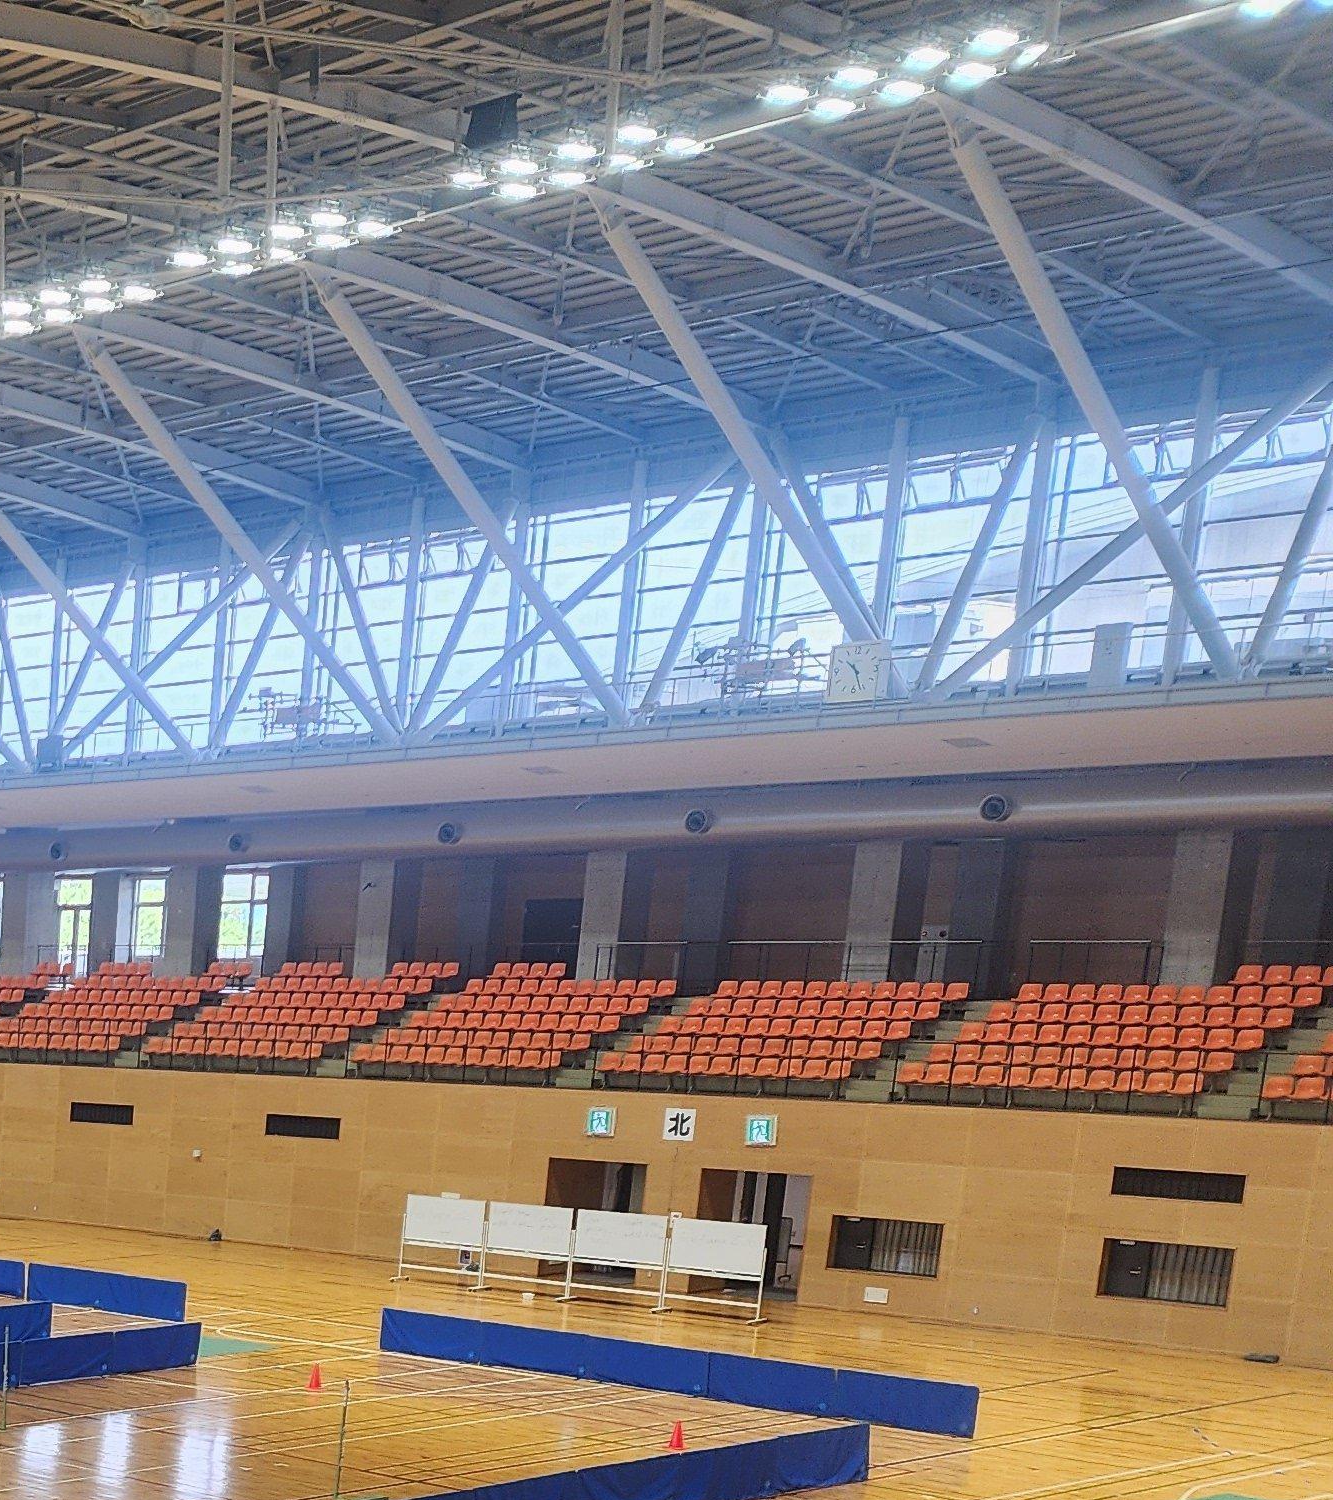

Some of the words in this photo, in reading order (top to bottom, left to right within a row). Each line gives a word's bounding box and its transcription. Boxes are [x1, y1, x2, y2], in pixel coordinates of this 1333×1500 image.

[854, 646, 862, 654] 12
[833, 668, 840, 676] 9
[873, 664, 879, 672] 3
[850, 685, 857, 694] 6
[668, 1112, 691, 1136] 北
